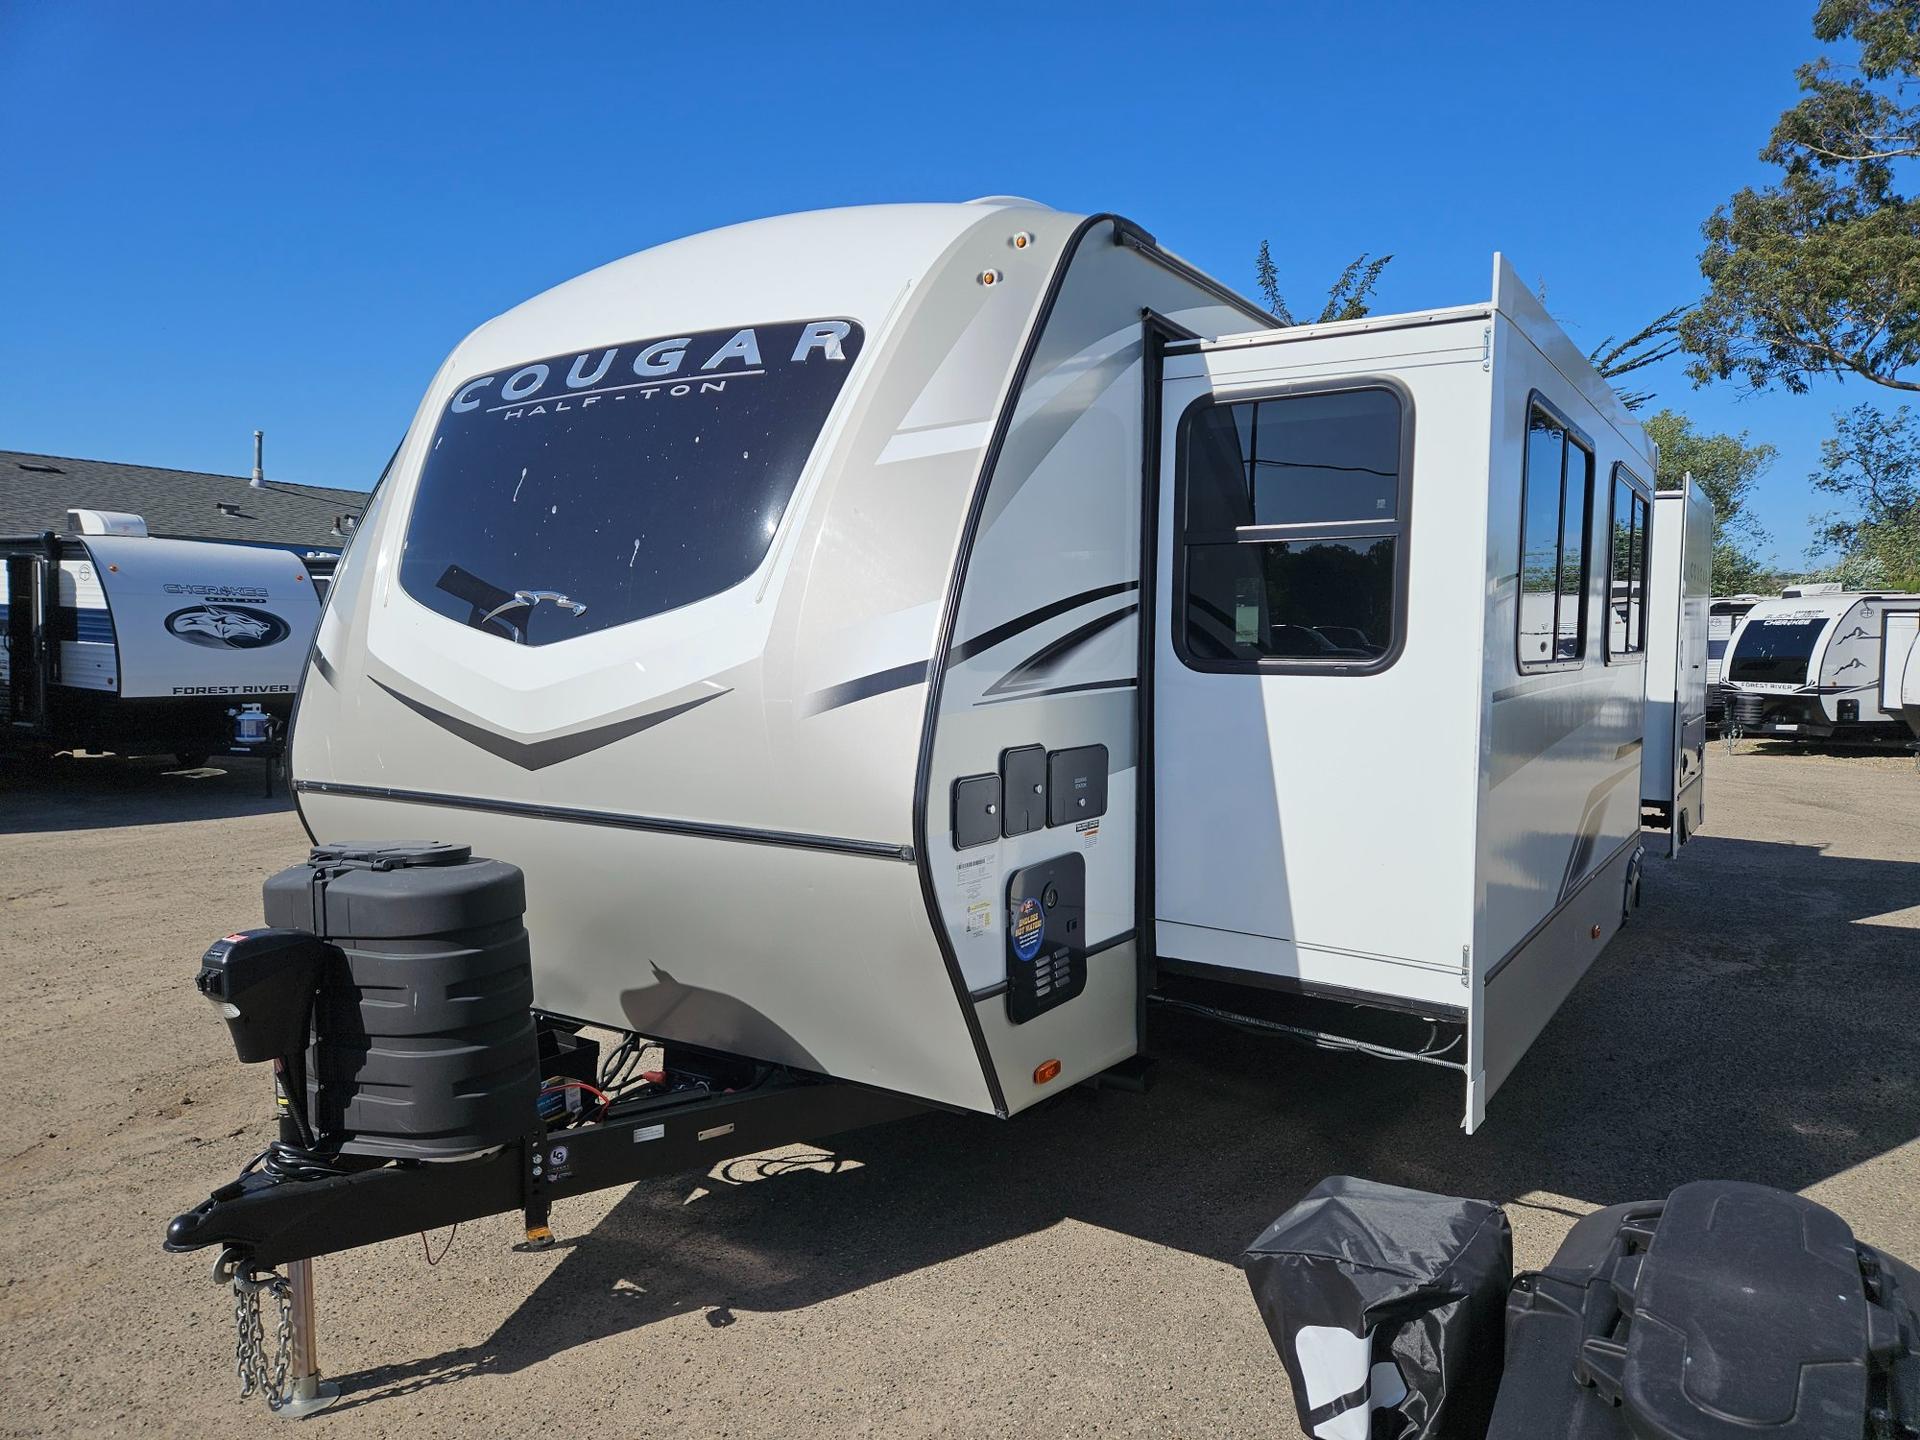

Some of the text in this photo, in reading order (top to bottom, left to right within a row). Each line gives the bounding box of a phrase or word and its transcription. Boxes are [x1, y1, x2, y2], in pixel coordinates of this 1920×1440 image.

[451, 320, 852, 414] COUGAR
[504, 380, 727, 421] HALF-TON
[172, 684, 289, 695] FOREST RIVER
